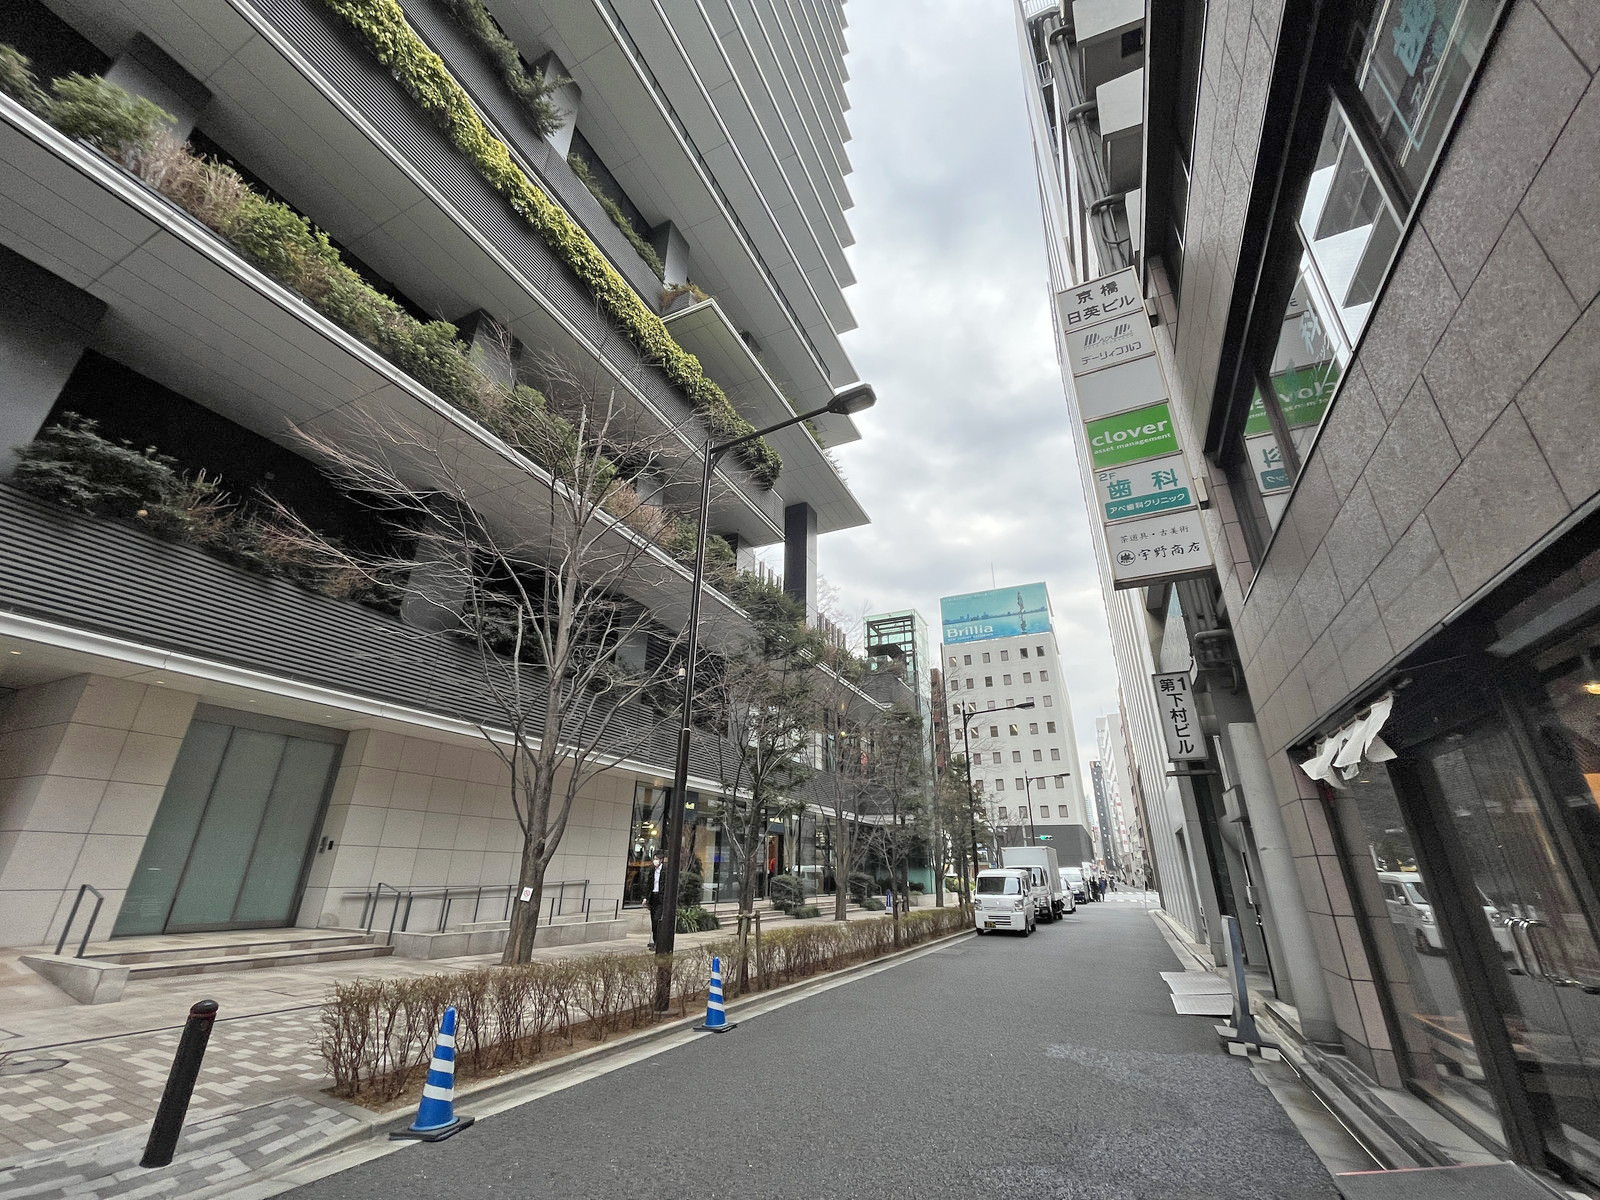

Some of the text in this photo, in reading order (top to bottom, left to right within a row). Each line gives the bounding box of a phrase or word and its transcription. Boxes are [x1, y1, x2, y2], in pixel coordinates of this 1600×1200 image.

[1067, 295, 1135, 325] 日英ビル
[1092, 420, 1168, 447] clover
[1094, 432, 1172, 455] asset management
[1099, 471, 1116, 482] 2F
[947, 624, 994, 638] Brillia
